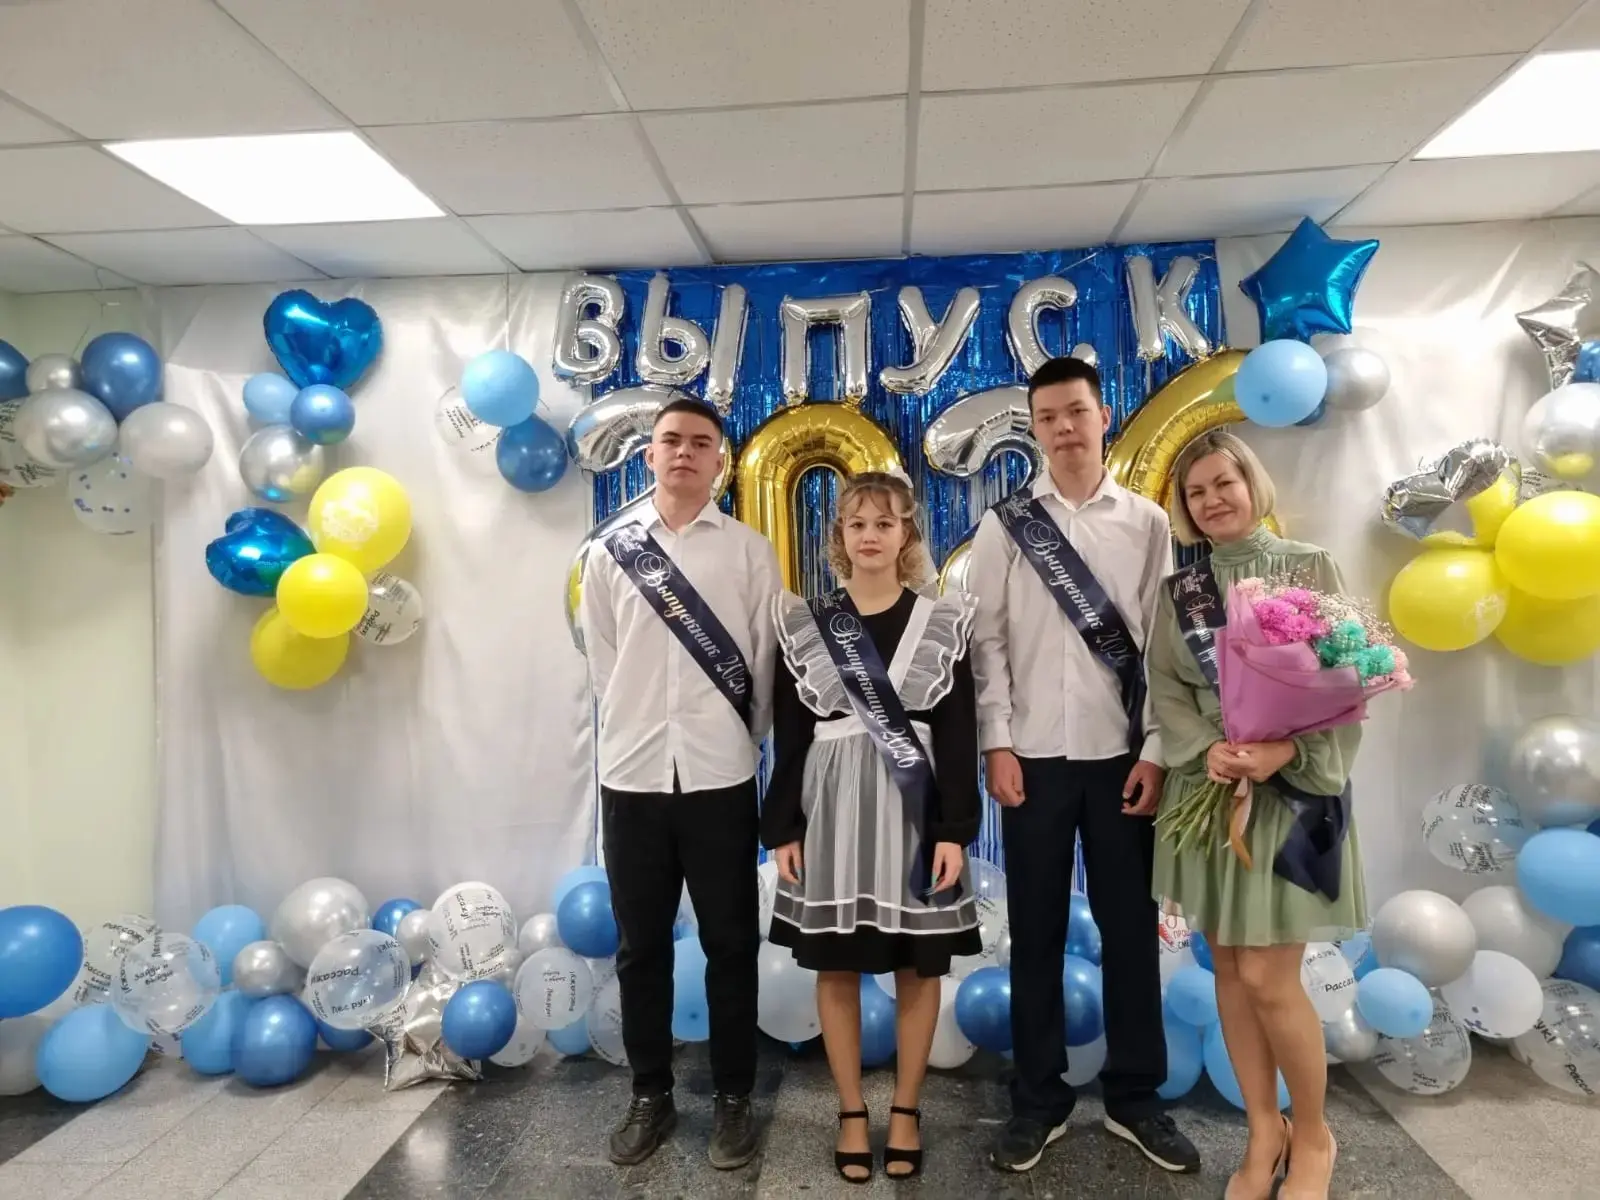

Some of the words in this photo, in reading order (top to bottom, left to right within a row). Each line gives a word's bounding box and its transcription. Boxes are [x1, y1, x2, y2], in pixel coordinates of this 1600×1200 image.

[551, 254, 1218, 412] ВЫПУСК
[634, 551, 721, 658] Выпускник
[1023, 519, 1104, 630] Выпускник
[829, 612, 892, 730] Выпускница
[880, 726, 925, 769] 2026
